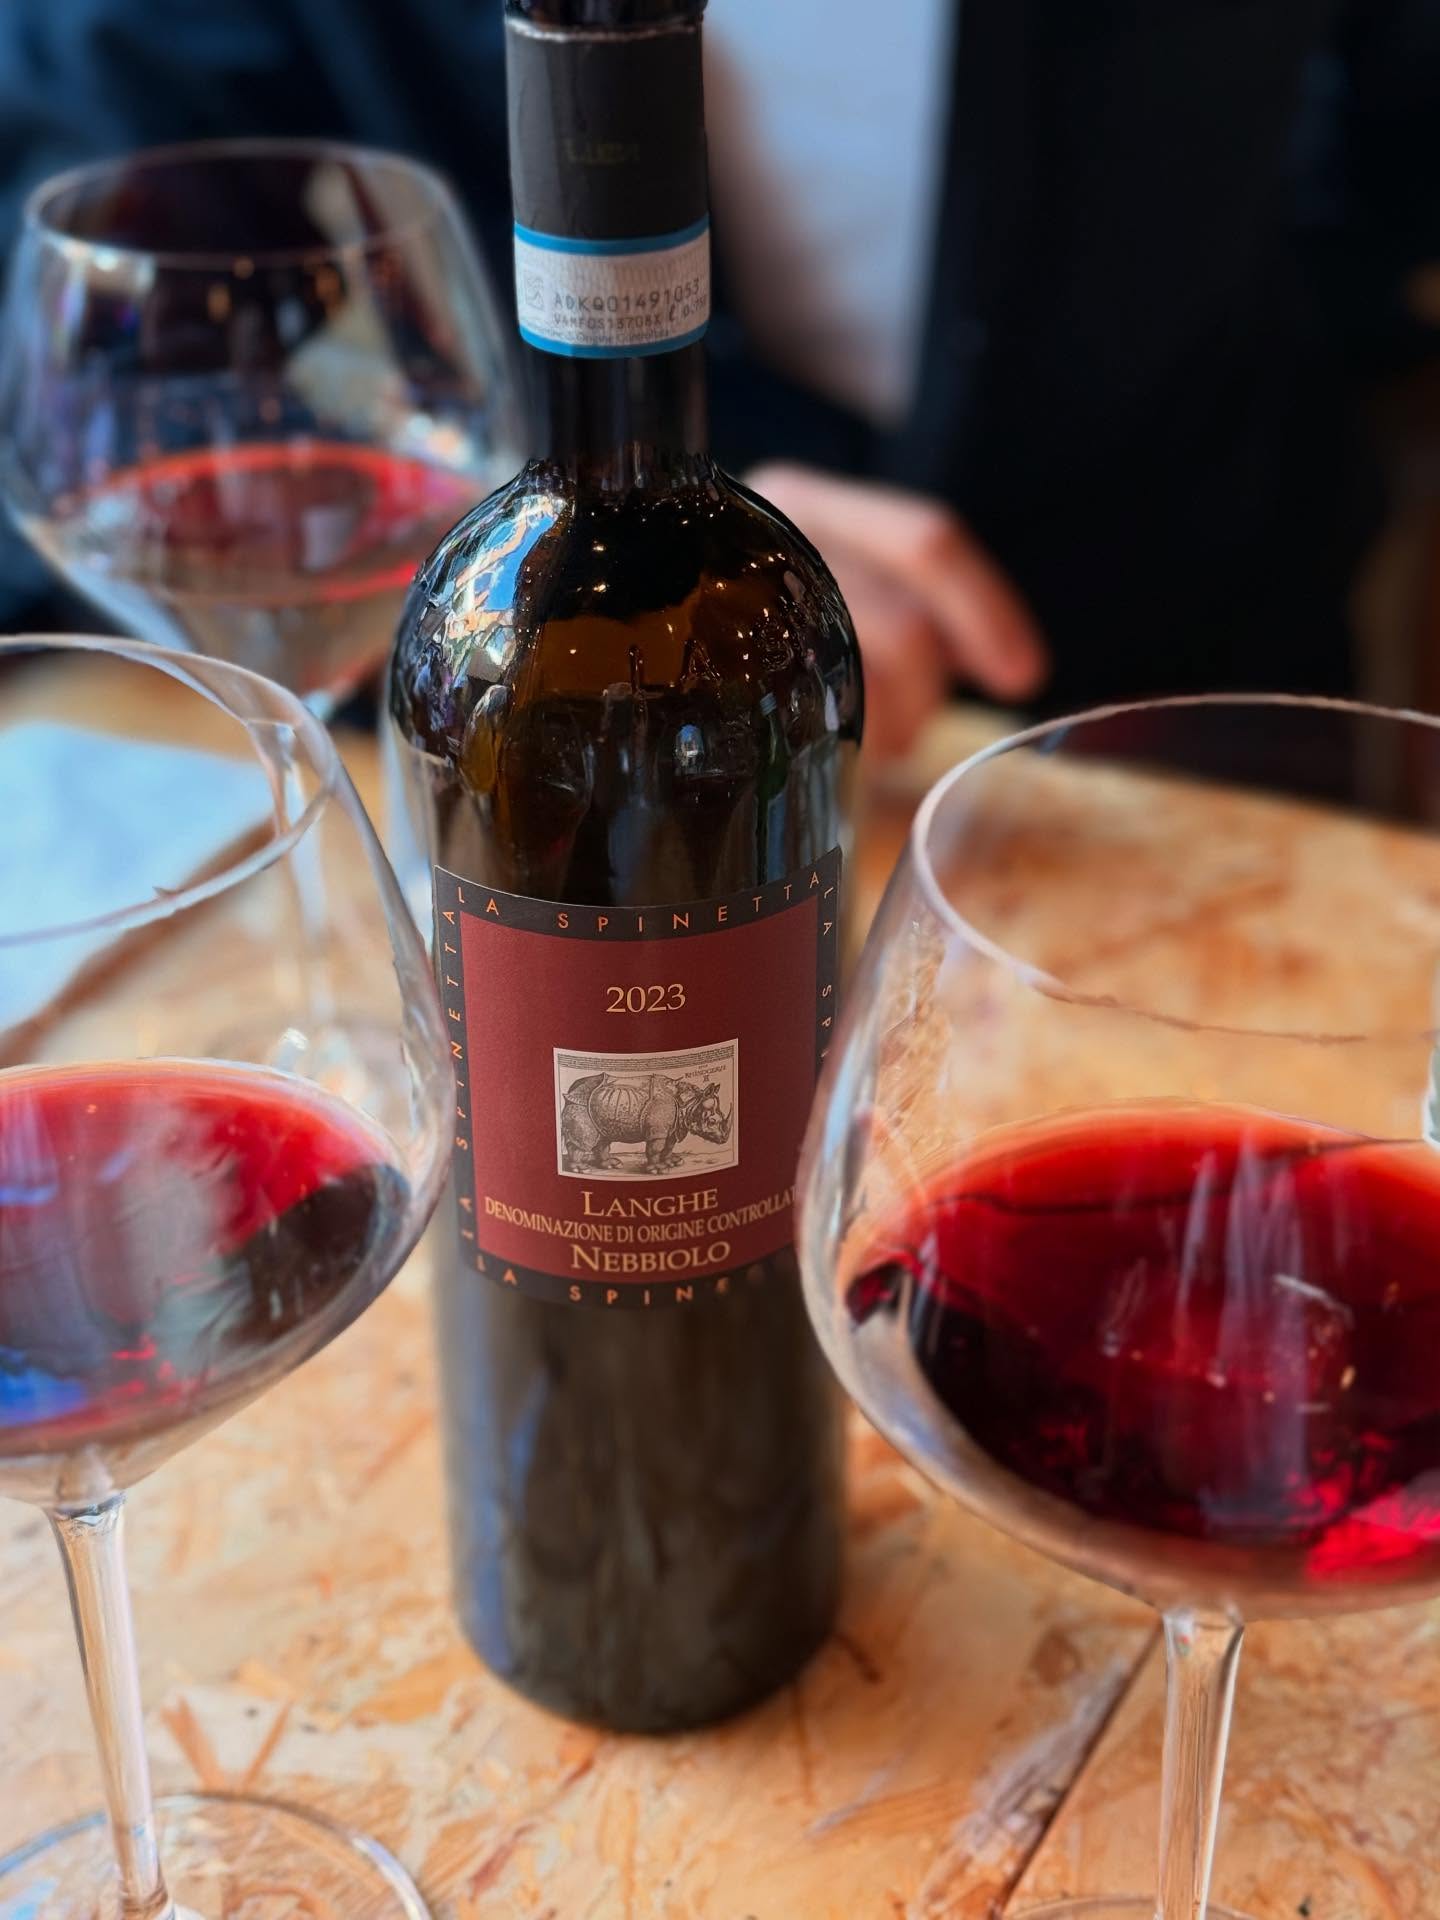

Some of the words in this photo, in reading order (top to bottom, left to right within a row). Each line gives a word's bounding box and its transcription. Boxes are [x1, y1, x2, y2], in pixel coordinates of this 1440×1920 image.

[457, 886, 500, 916] LA
[557, 871, 820, 932] SPINETTA
[605, 983, 687, 1013] 2023
[580, 1188, 719, 1218] LANGHE
[483, 1195, 614, 1243] DENOMINAZIONE
[616, 1225, 634, 1244] DI
[636, 1218, 705, 1244] ORIGINE
[570, 1241, 732, 1273] NEBBIOLO
